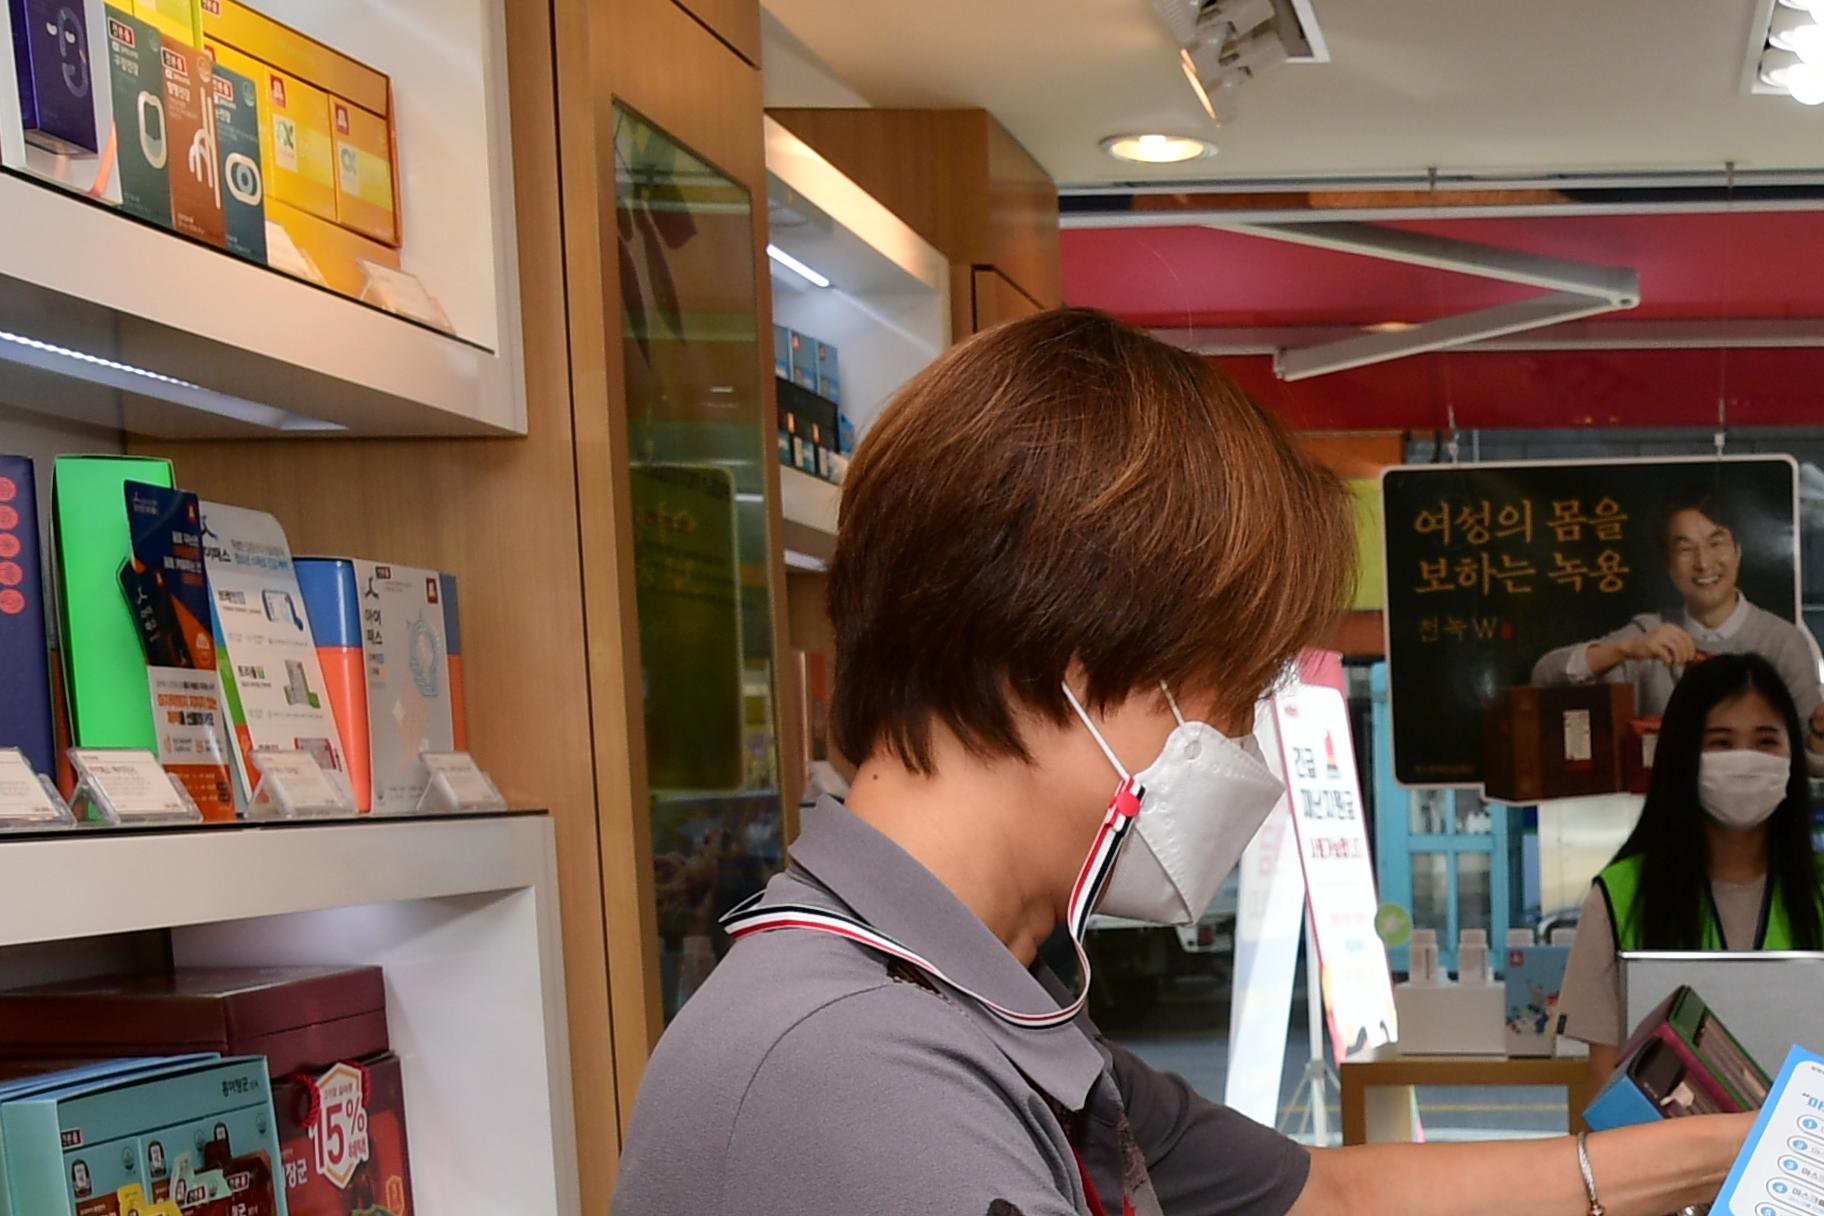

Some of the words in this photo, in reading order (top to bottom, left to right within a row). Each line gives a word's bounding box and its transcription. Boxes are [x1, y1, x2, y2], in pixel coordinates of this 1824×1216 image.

[1414, 499, 1531, 546] 여성의
[1547, 497, 1628, 541] 몸을
[1415, 551, 1537, 596] 보하는
[1547, 549, 1630, 593] 녹용
[315, 1096, 365, 1169] 15%
